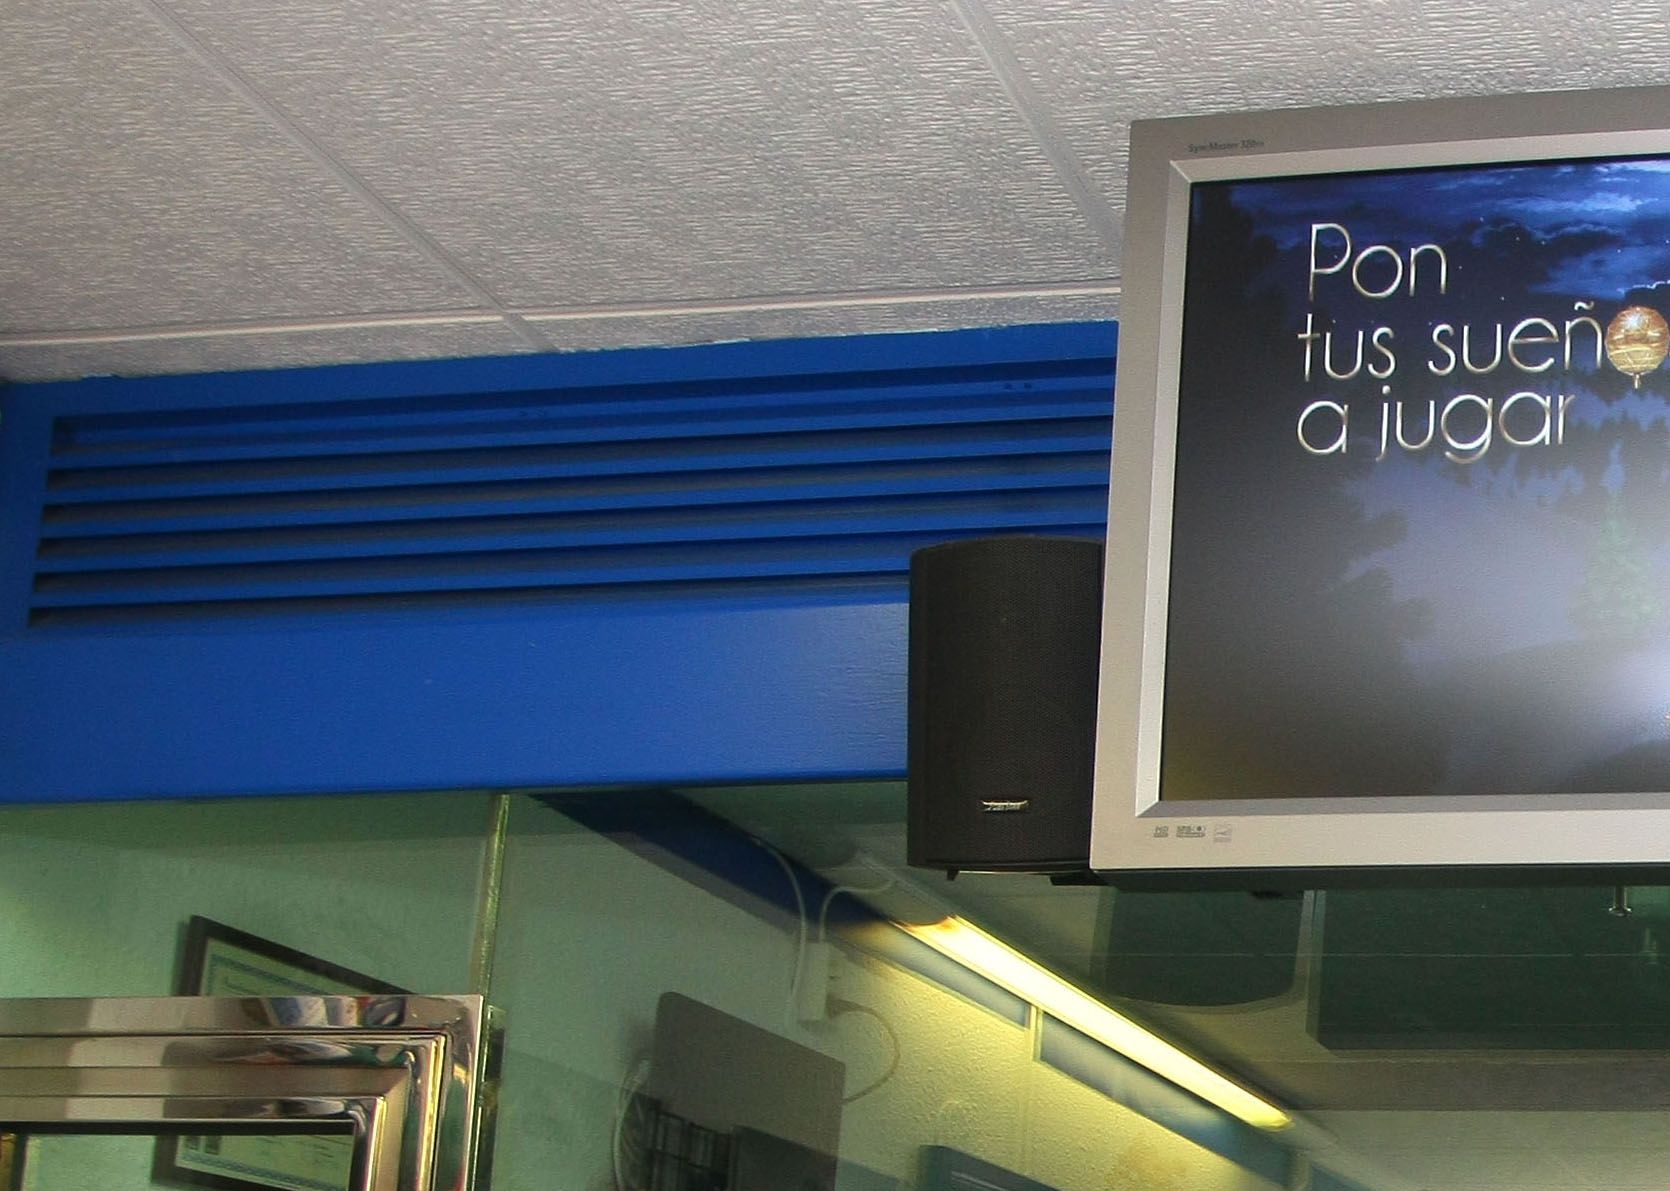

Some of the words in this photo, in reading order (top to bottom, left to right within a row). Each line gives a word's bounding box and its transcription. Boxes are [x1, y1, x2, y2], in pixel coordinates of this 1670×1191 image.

[1307, 222, 1449, 302] Pon
[1298, 309, 1396, 382] tus
[1298, 400, 1350, 456] a
[1376, 384, 1576, 464] jugar
